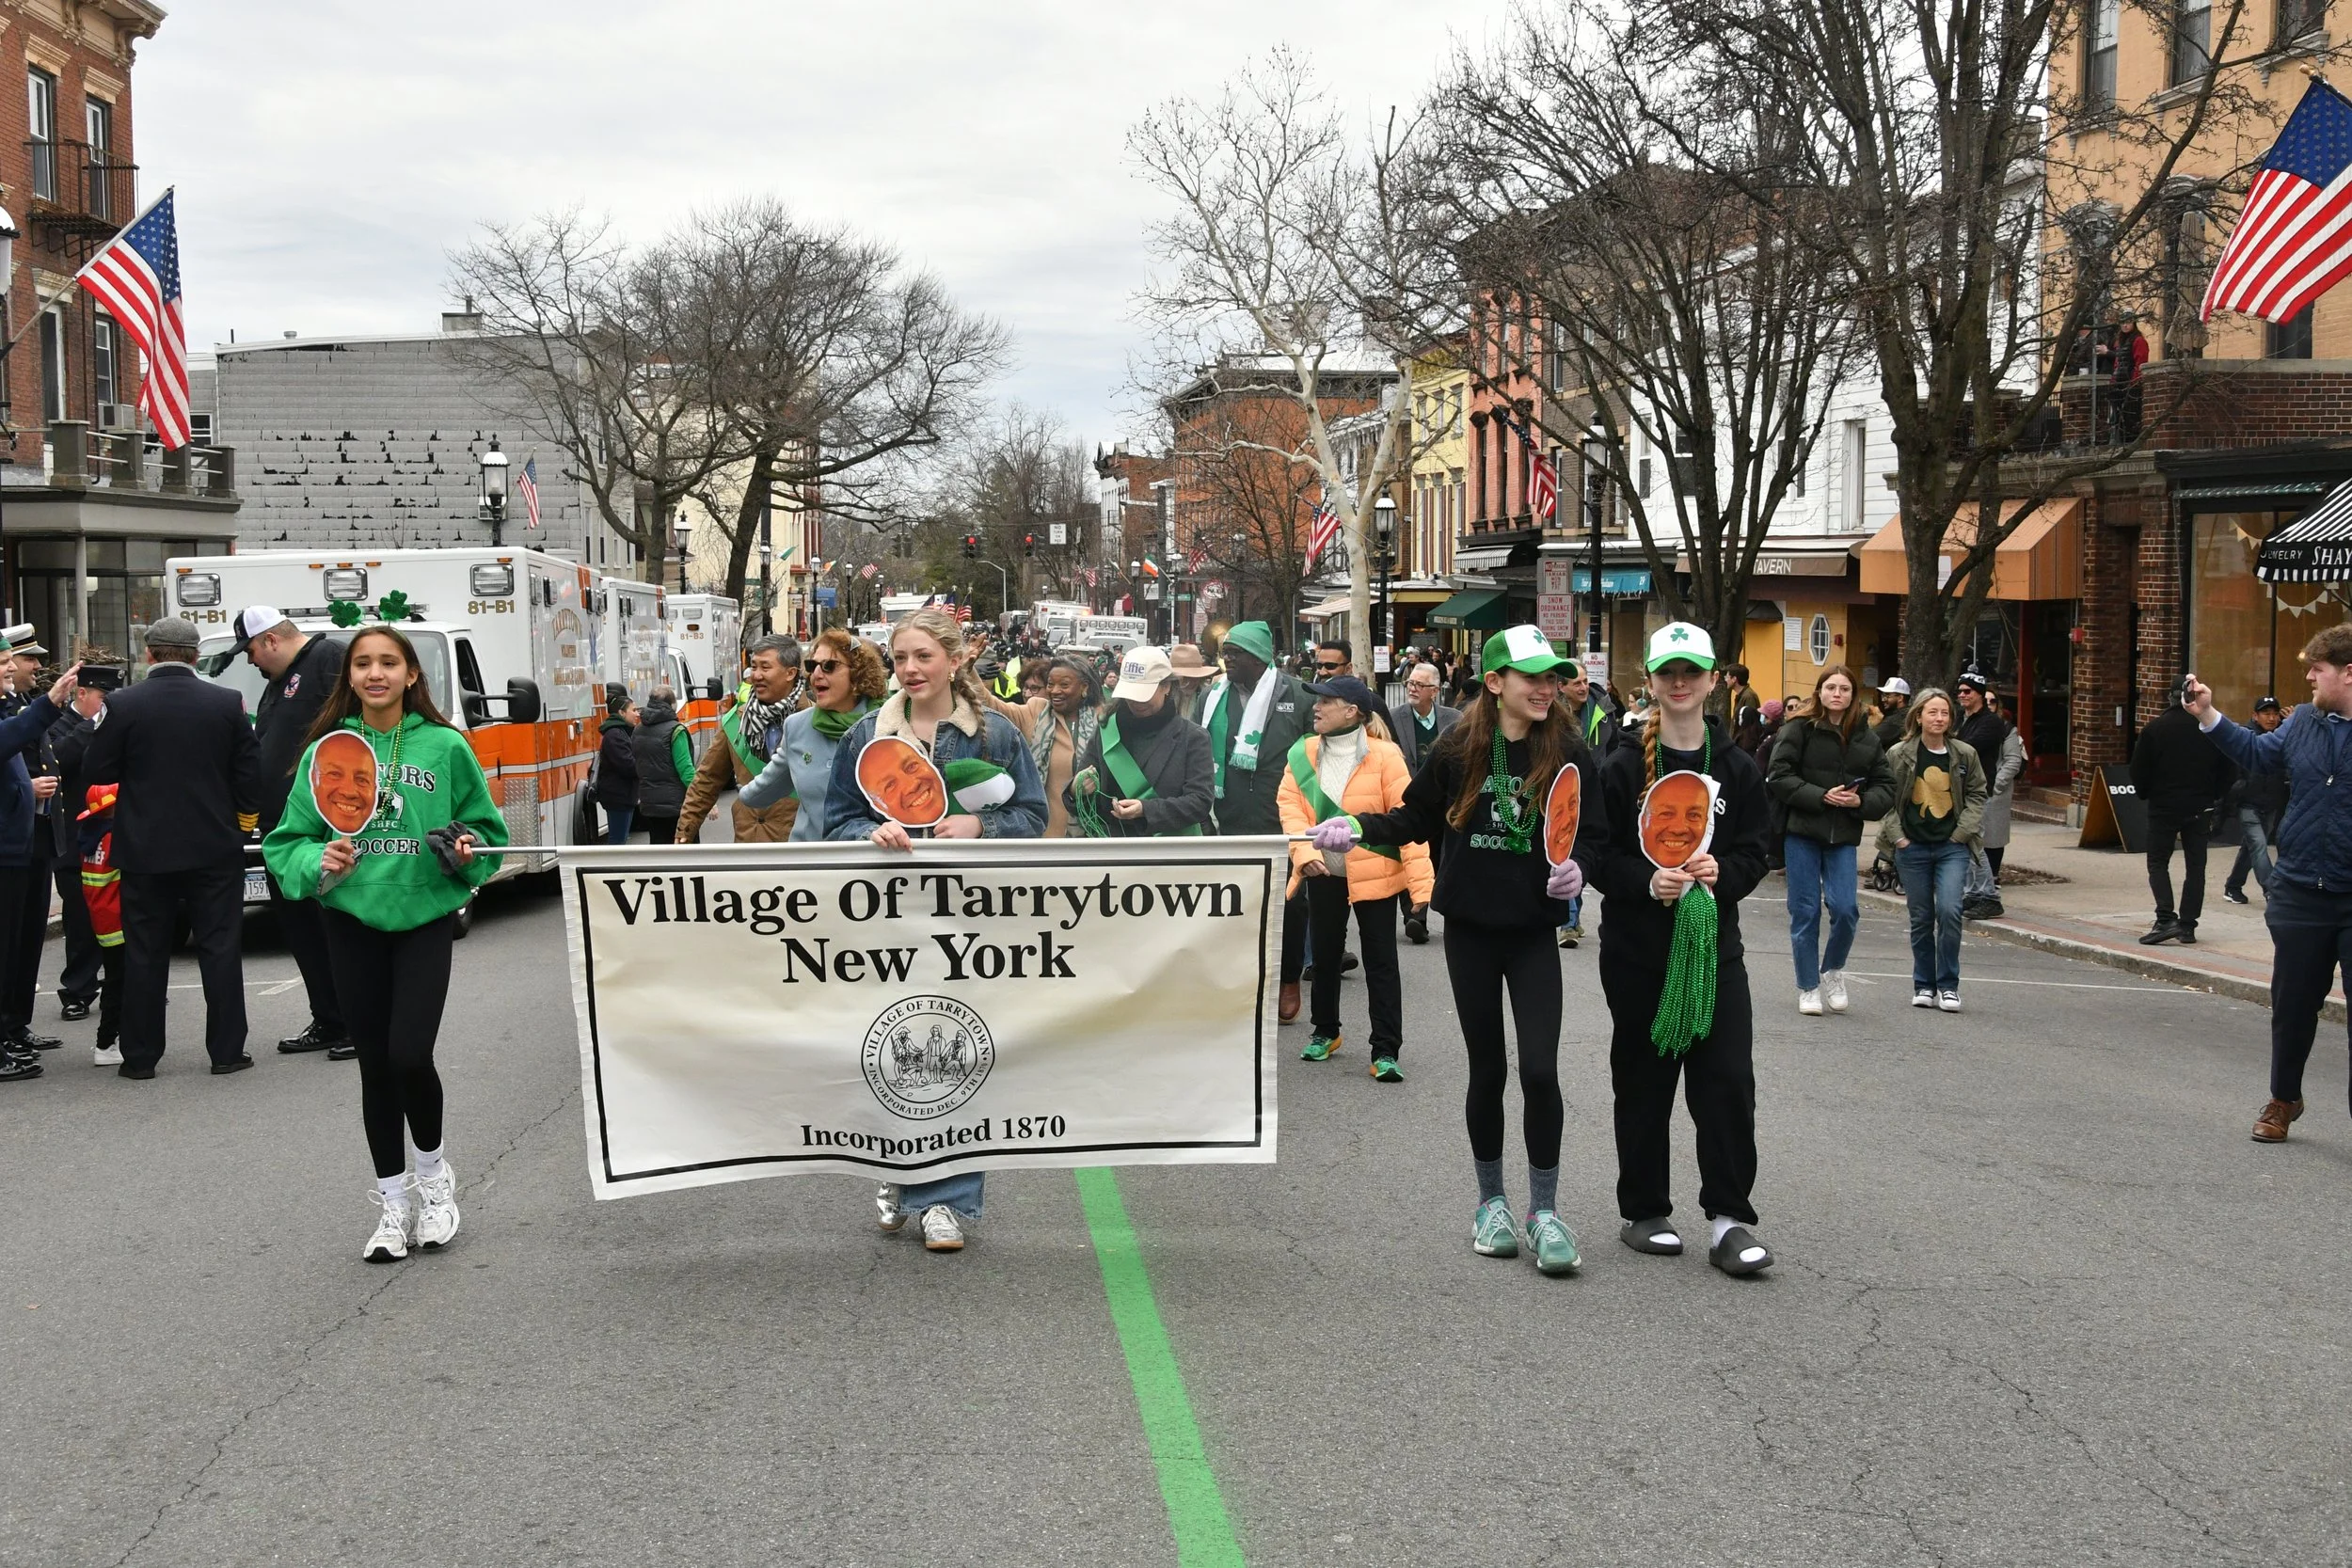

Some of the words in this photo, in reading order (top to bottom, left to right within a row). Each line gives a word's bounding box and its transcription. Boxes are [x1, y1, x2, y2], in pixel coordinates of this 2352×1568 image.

[1753, 558, 1791, 575] TAVERN
[2260, 549, 2303, 560] JEWELRY
[180, 610, 227, 624] 81-B1
[467, 599, 515, 615] 81-B1
[1123, 661, 1145, 673] Effie
[603, 876, 818, 936] Village
[839, 876, 908, 922] Of
[921, 873, 1245, 930] Tarrytown
[781, 939, 918, 984] New
[931, 931, 1076, 981] York
[866, 1006, 905, 1058] VILLAGE
[906, 1000, 924, 1012] OF
[927, 1000, 991, 1055] TARRYTOWN
[868, 1069, 934, 1116] INCORPORATED
[937, 1097, 961, 1112] DEC.
[961, 1081, 978, 1097] 9TH
[801, 1117, 992, 1160] Incorporated
[1003, 1116, 1066, 1140] 1870
